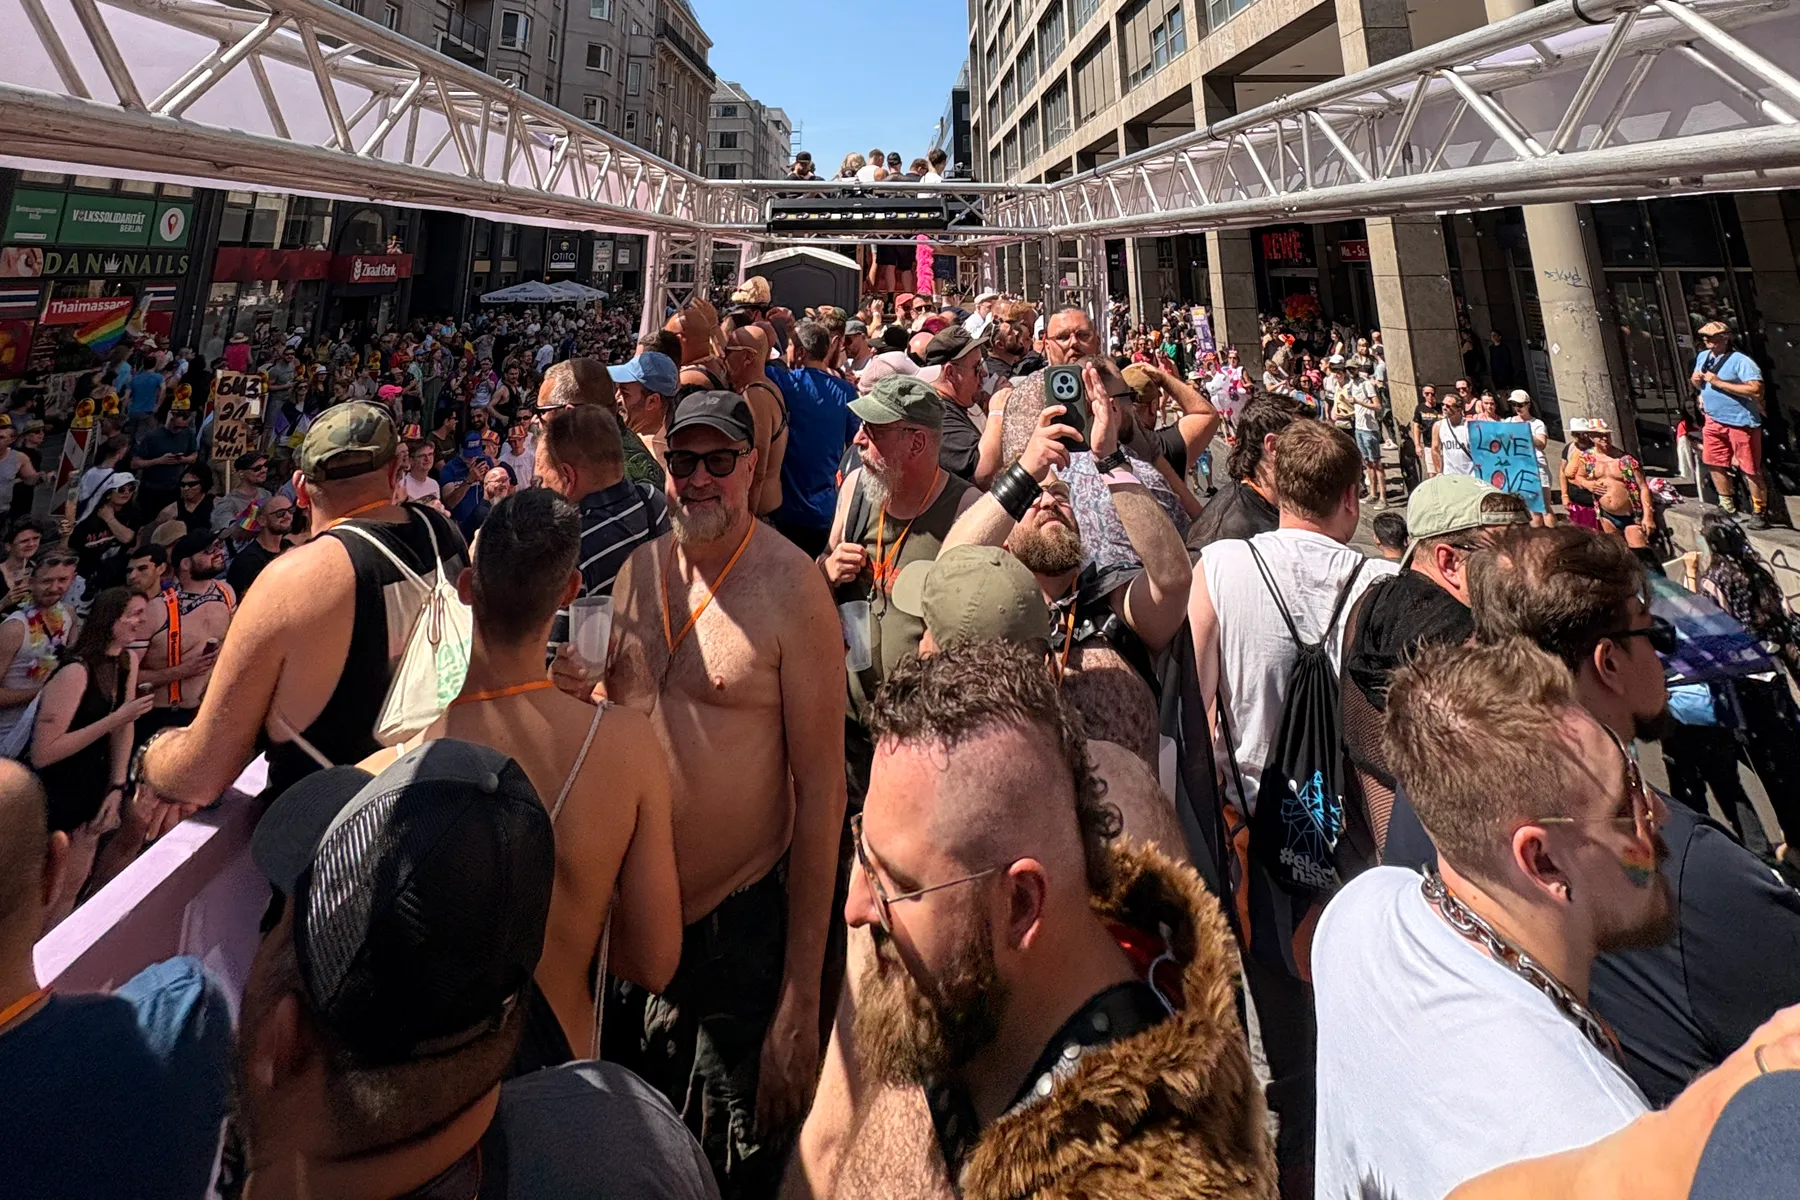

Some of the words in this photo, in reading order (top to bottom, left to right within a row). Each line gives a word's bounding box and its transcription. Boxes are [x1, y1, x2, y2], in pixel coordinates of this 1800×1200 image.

[120, 224, 142, 233] BERLIN
[1262, 231, 1303, 260] REWE
[552, 252, 576, 261] OTITO
[43, 252, 102, 274] DAN
[121, 254, 189, 275] NAILS
[362, 263, 381, 277] Ziraat
[381, 263, 396, 277] Bank
[1442, 440, 1470, 451] ADID
[1477, 426, 1531, 457] LOVE
[1494, 457, 1511, 467] is
